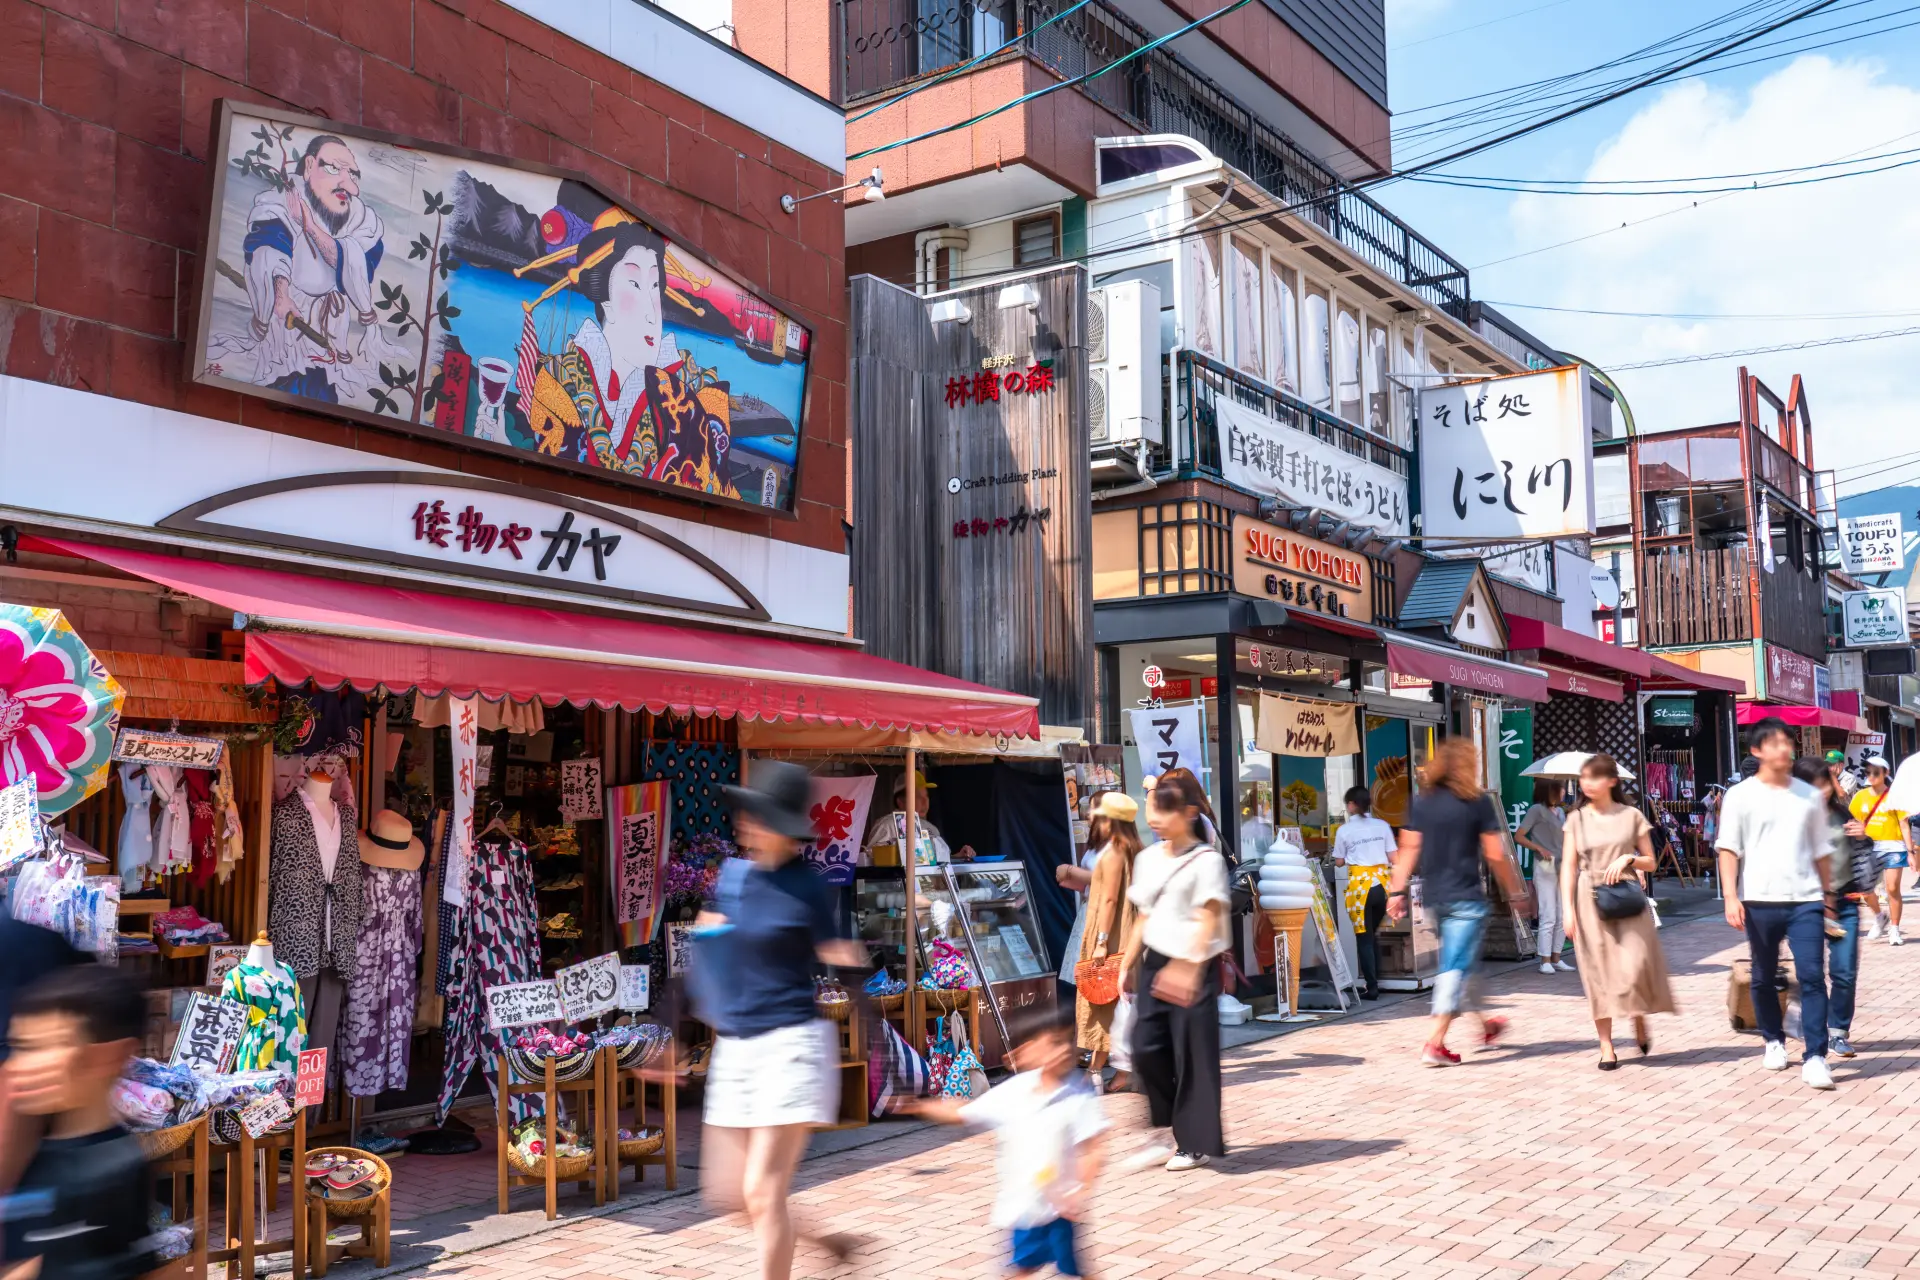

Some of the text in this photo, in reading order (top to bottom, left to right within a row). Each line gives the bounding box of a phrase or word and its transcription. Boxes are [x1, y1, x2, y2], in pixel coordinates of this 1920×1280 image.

[982, 354, 1015, 369] 軽井沢
[944, 360, 1054, 409] 林檎の森
[1433, 394, 1532, 428] そば処
[963, 468, 1057, 489] Craft Pudding Plant
[1228, 424, 1403, 526] 自家製手打そば・うどん
[1453, 458, 1572, 520] にし川
[1855, 519, 1893, 528] handicraft
[412, 500, 621, 580] 倭物やカヤ
[1845, 528, 1897, 542] TOUFU
[1246, 528, 1362, 586] SUGI YOHOEN
[1850, 543, 1894, 557] とうふ
[1851, 556, 1891, 564] KARUIZAWA
[1449, 665, 1468, 681] SUGI
[1471, 670, 1504, 688] YOHOEN
[1653, 708, 1691, 718] Stream
[223, 1009, 243, 1041] 子供
[298, 1076, 325, 1094] OFF
